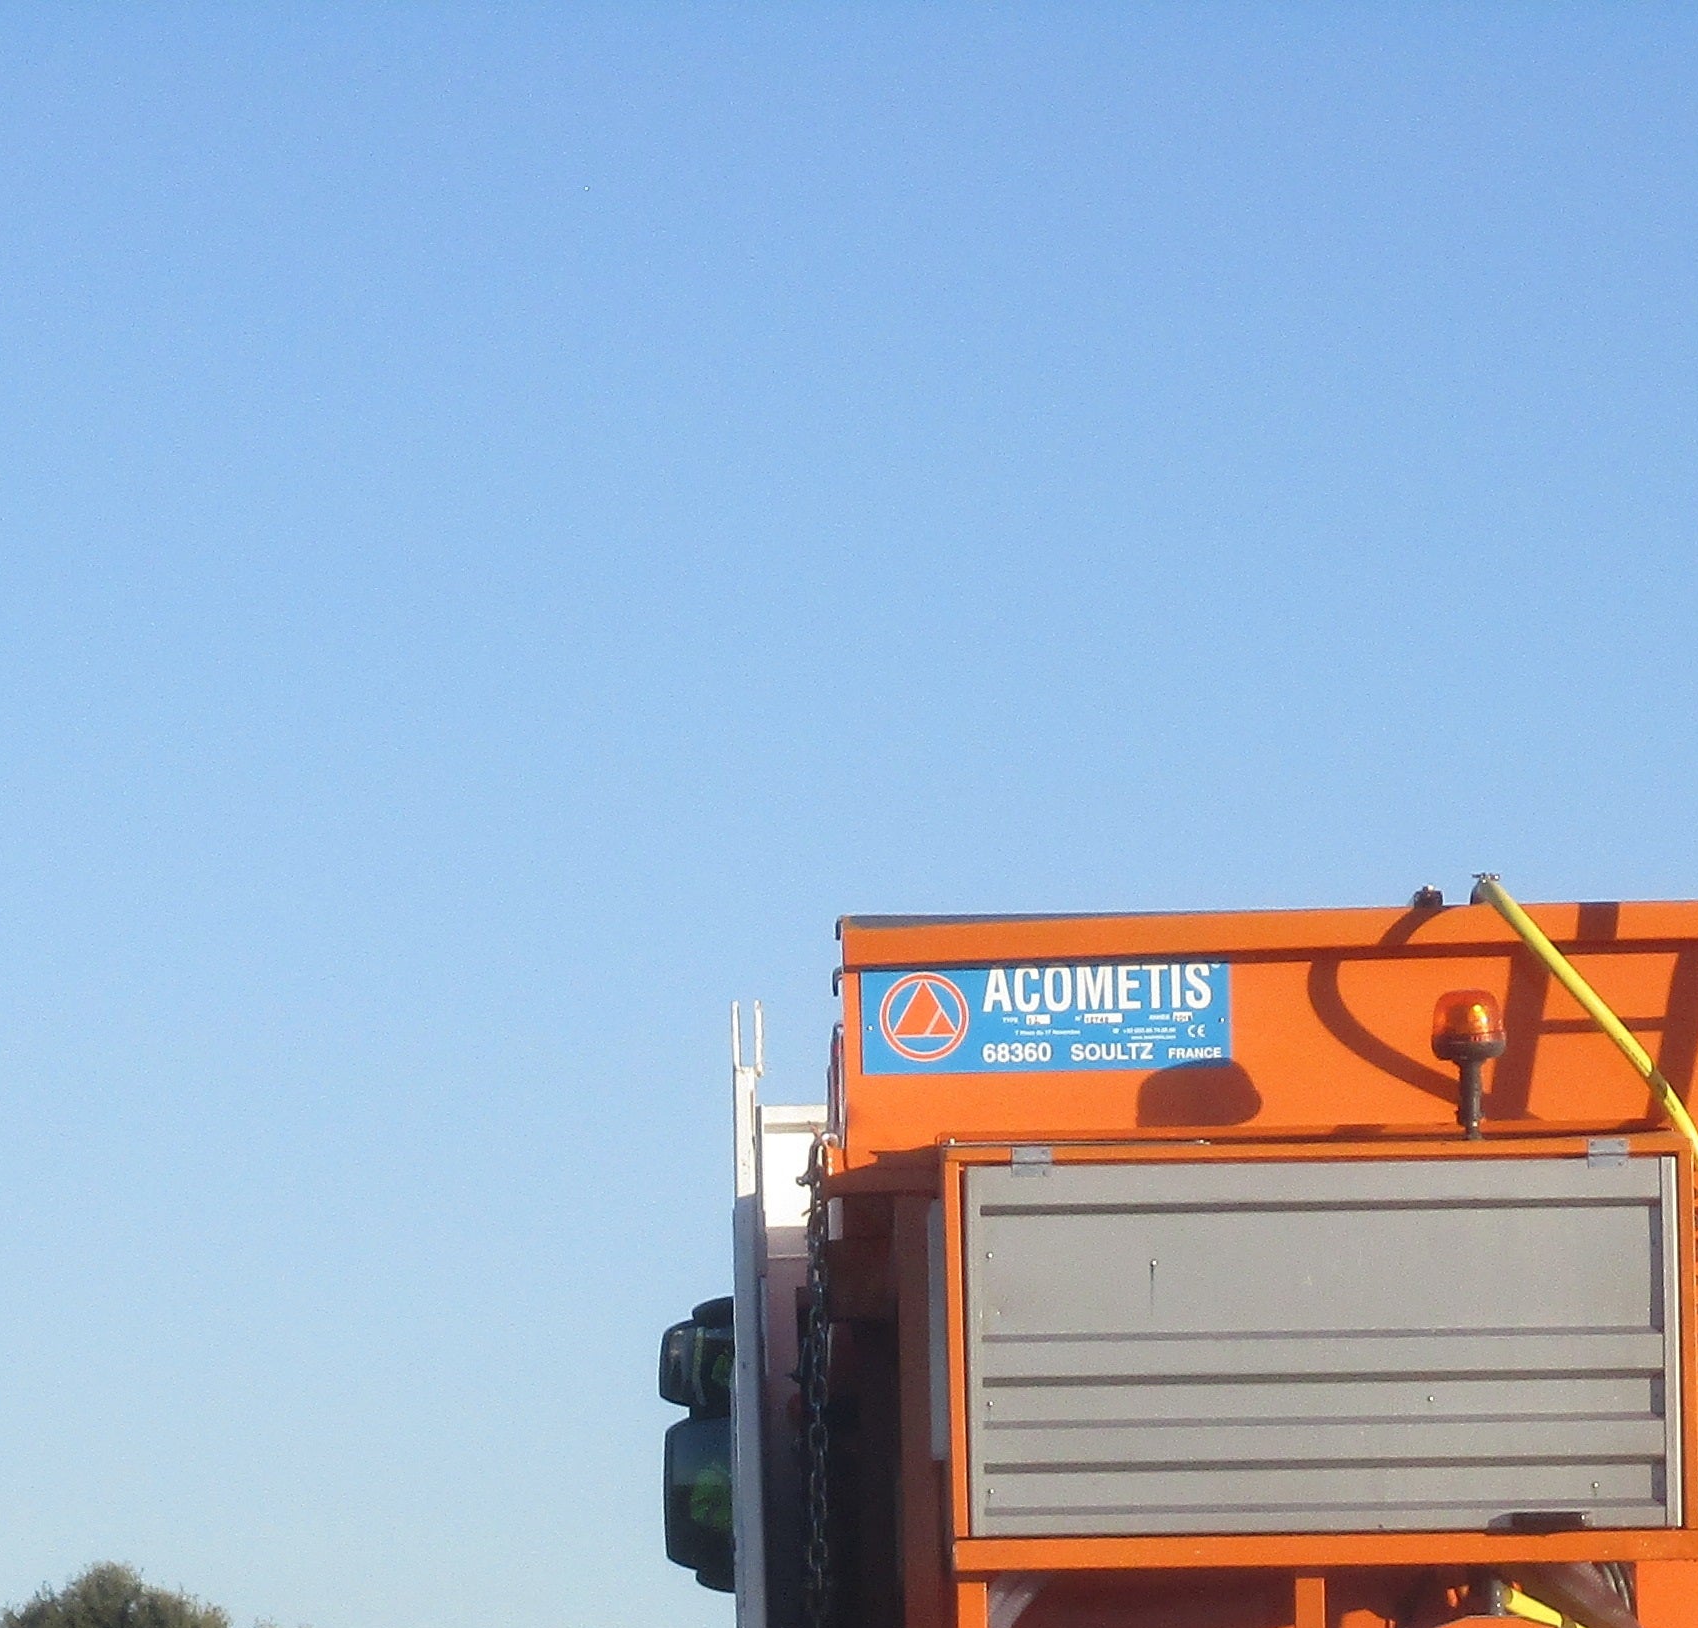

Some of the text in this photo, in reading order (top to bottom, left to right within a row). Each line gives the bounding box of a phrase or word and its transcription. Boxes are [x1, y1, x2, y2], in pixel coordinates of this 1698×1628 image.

[982, 964, 1212, 1013] ACOMETIS
[982, 1043, 1222, 1063] 68360 SOULTZ FRANCE
